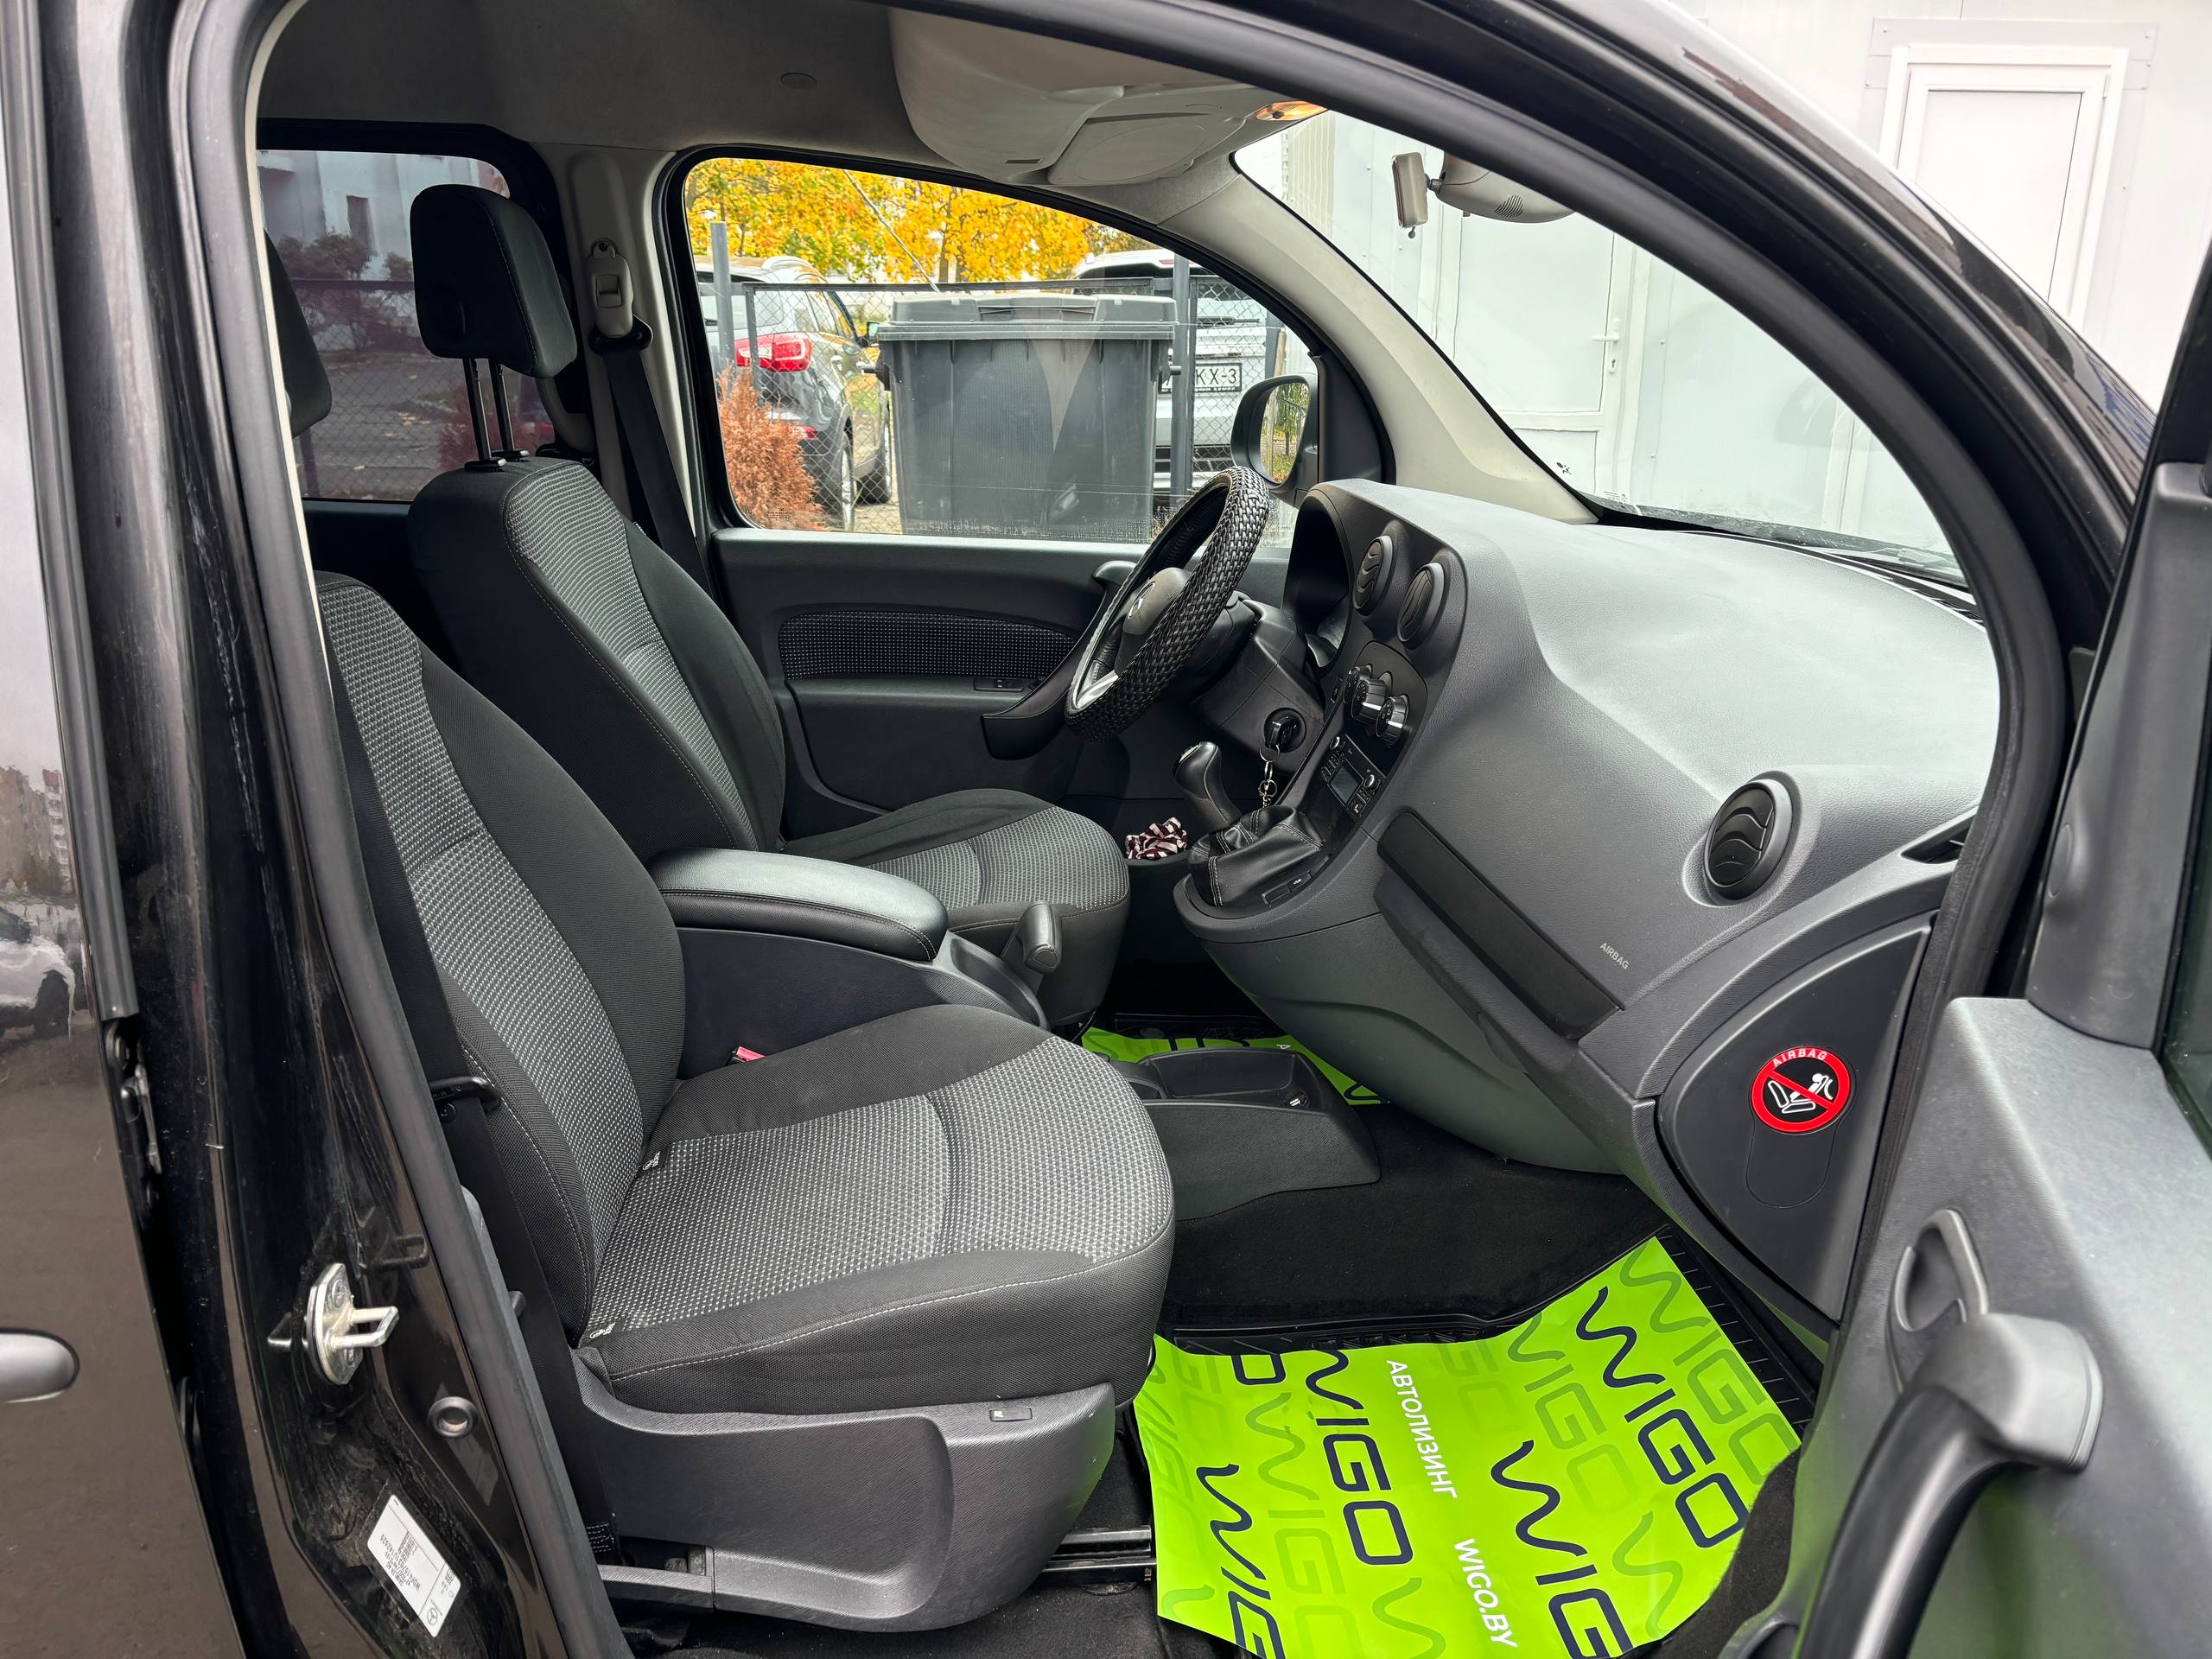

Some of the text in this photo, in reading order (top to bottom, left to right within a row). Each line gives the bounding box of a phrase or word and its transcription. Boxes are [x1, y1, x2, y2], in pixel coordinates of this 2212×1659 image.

[1599, 942, 1630, 969] AIRBAG
[1772, 1048, 1827, 1068] AIRBAG
[1386, 1359, 1458, 1499] АВТОЛИЗИНГ
[1576, 1286, 1751, 1548] WIGO
[1453, 1538, 1517, 1649] WIGO.BY
